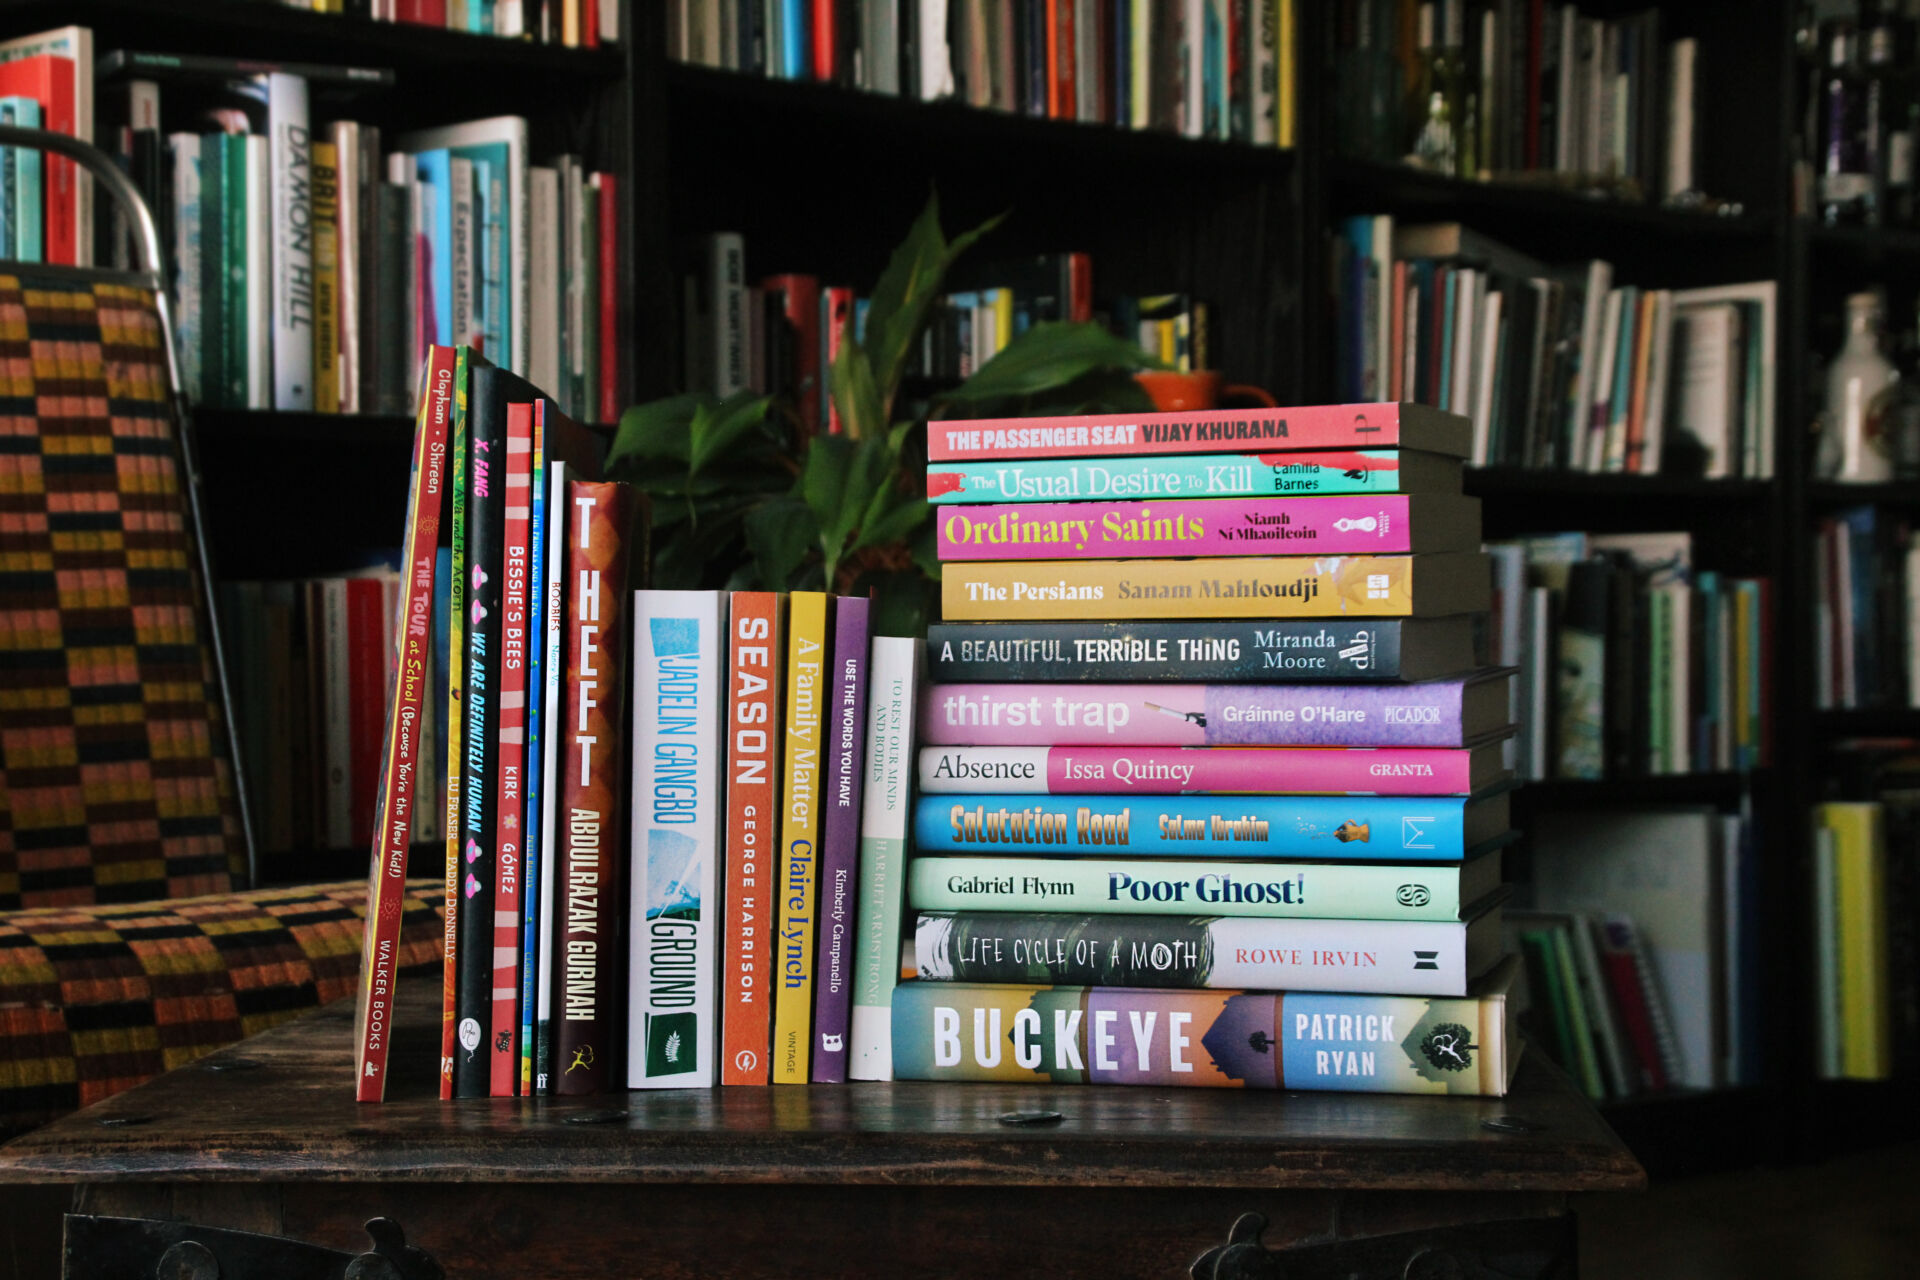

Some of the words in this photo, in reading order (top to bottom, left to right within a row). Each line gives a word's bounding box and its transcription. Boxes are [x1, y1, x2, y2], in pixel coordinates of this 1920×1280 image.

[288, 123, 312, 254] DAMON
[289, 262, 312, 331] HILL
[432, 368, 452, 424] Clapham
[474, 437, 489, 454] X.
[946, 431, 981, 451] THE
[983, 426, 1089, 450] PASSENGER
[1091, 424, 1138, 445] SEAT
[1141, 423, 1193, 443] VIJAY
[1196, 419, 1289, 441] KHURANA
[427, 442, 445, 495] Shireen
[473, 458, 489, 498] FANG
[971, 476, 997, 490] The
[996, 467, 1079, 497] Usual
[1087, 466, 1181, 495] Desire
[1185, 475, 1202, 488] To
[1205, 465, 1254, 493] Kill
[1272, 461, 1320, 476] Camilla
[1275, 477, 1319, 490] Barnes
[454, 488, 465, 515] Ava
[1244, 510, 1290, 525] Niamh
[453, 519, 464, 541] and
[945, 512, 1095, 550] Ordinary
[1102, 508, 1205, 541] Saints
[1218, 528, 1233, 541] Ní
[1236, 526, 1317, 541] Mhaoileoin
[453, 543, 463, 561] the
[416, 556, 431, 588] THE
[453, 567, 464, 612] Acorn
[507, 545, 525, 623] BESSIE'S
[551, 582, 561, 631] BOOBIES
[964, 582, 1008, 601] The
[1012, 580, 1104, 601] Persians
[1118, 580, 1193, 599] Sanam
[1200, 578, 1319, 603] Mahloudji
[409, 640, 418, 655] at
[471, 631, 486, 657] WE
[506, 627, 523, 670] BEES
[575, 497, 600, 787] THEFT
[798, 637, 820, 656] A
[940, 640, 954, 662] A
[1253, 629, 1336, 649] Miranda
[470, 658, 486, 691] ARE
[845, 659, 857, 682] USE
[1263, 651, 1326, 669] Moore
[404, 658, 422, 702] School
[657, 658, 699, 735] JADELIN
[844, 684, 856, 705] THE
[893, 678, 903, 697] TO
[736, 617, 769, 784] SEASON
[789, 661, 820, 743] Family
[875, 704, 887, 732] AND
[891, 699, 902, 731] REST
[943, 695, 1042, 727] thirst
[1052, 696, 1130, 734] trap
[1223, 704, 1295, 722] Gráinne
[1300, 706, 1366, 723] O'Hare
[1385, 706, 1441, 723] PICADOR
[400, 706, 416, 758] (Because
[468, 692, 485, 773] DEFINITELY
[841, 707, 855, 749] WORDS
[840, 750, 852, 776] YOU
[873, 735, 885, 784] BODIES
[888, 733, 900, 765] OUR
[397, 762, 412, 793] You're
[448, 776, 460, 792] LU
[504, 765, 518, 800] KIRK
[653, 742, 698, 824] GANGBO
[933, 754, 1036, 780] Absence
[1063, 758, 1105, 780] Issa
[1112, 758, 1194, 785] Quincy
[1369, 763, 1434, 776] GRANTA
[396, 796, 407, 816] the
[467, 775, 483, 833] HUMAN
[791, 748, 816, 829] Matter
[839, 776, 851, 807] HAVE
[886, 768, 899, 811] MINDS
[393, 819, 407, 846] New
[447, 795, 460, 841] FRASER
[950, 804, 1068, 845] Salutation
[1076, 806, 1130, 846] Road
[1159, 813, 1206, 841] Salma
[1210, 814, 1269, 842] Ibrahim
[743, 805, 756, 887] GEORGE
[388, 849, 403, 879] Kid!)
[446, 856, 459, 895] PADDY
[501, 842, 516, 894] GÓMEZ
[568, 808, 600, 934] ABDULRAZAK
[788, 839, 812, 910] Claire
[872, 840, 887, 909] HARRIET
[831, 869, 847, 922] Kimberly
[947, 875, 1014, 895] Gabriel
[1022, 876, 1075, 899] Flynn
[1108, 871, 1190, 903] Poor
[1195, 872, 1305, 905] Ghost!
[445, 897, 458, 960] DONNELLY
[375, 940, 391, 995] WALKER
[649, 922, 697, 1008] GROUND
[741, 897, 755, 1003] HARRISON
[780, 917, 809, 989] Lynch
[830, 923, 844, 993] Campanello
[867, 911, 883, 1004] ARMSTRONG
[957, 936, 1003, 966] LIFE
[1014, 938, 1066, 967] CYCLE
[1075, 939, 1099, 969] OF
[1111, 940, 1121, 969] A
[1131, 939, 1198, 971] MOTH
[1236, 948, 1303, 966] ROWE
[1312, 949, 1378, 968] IRVIN
[565, 940, 598, 1021] GURNAH
[369, 1001, 385, 1050] BOOKS
[933, 1006, 1194, 1073] BUCKEYE
[1296, 1013, 1395, 1043] PATRICK
[786, 1031, 796, 1073] VINTAGE
[1316, 1050, 1376, 1076] RYAN
